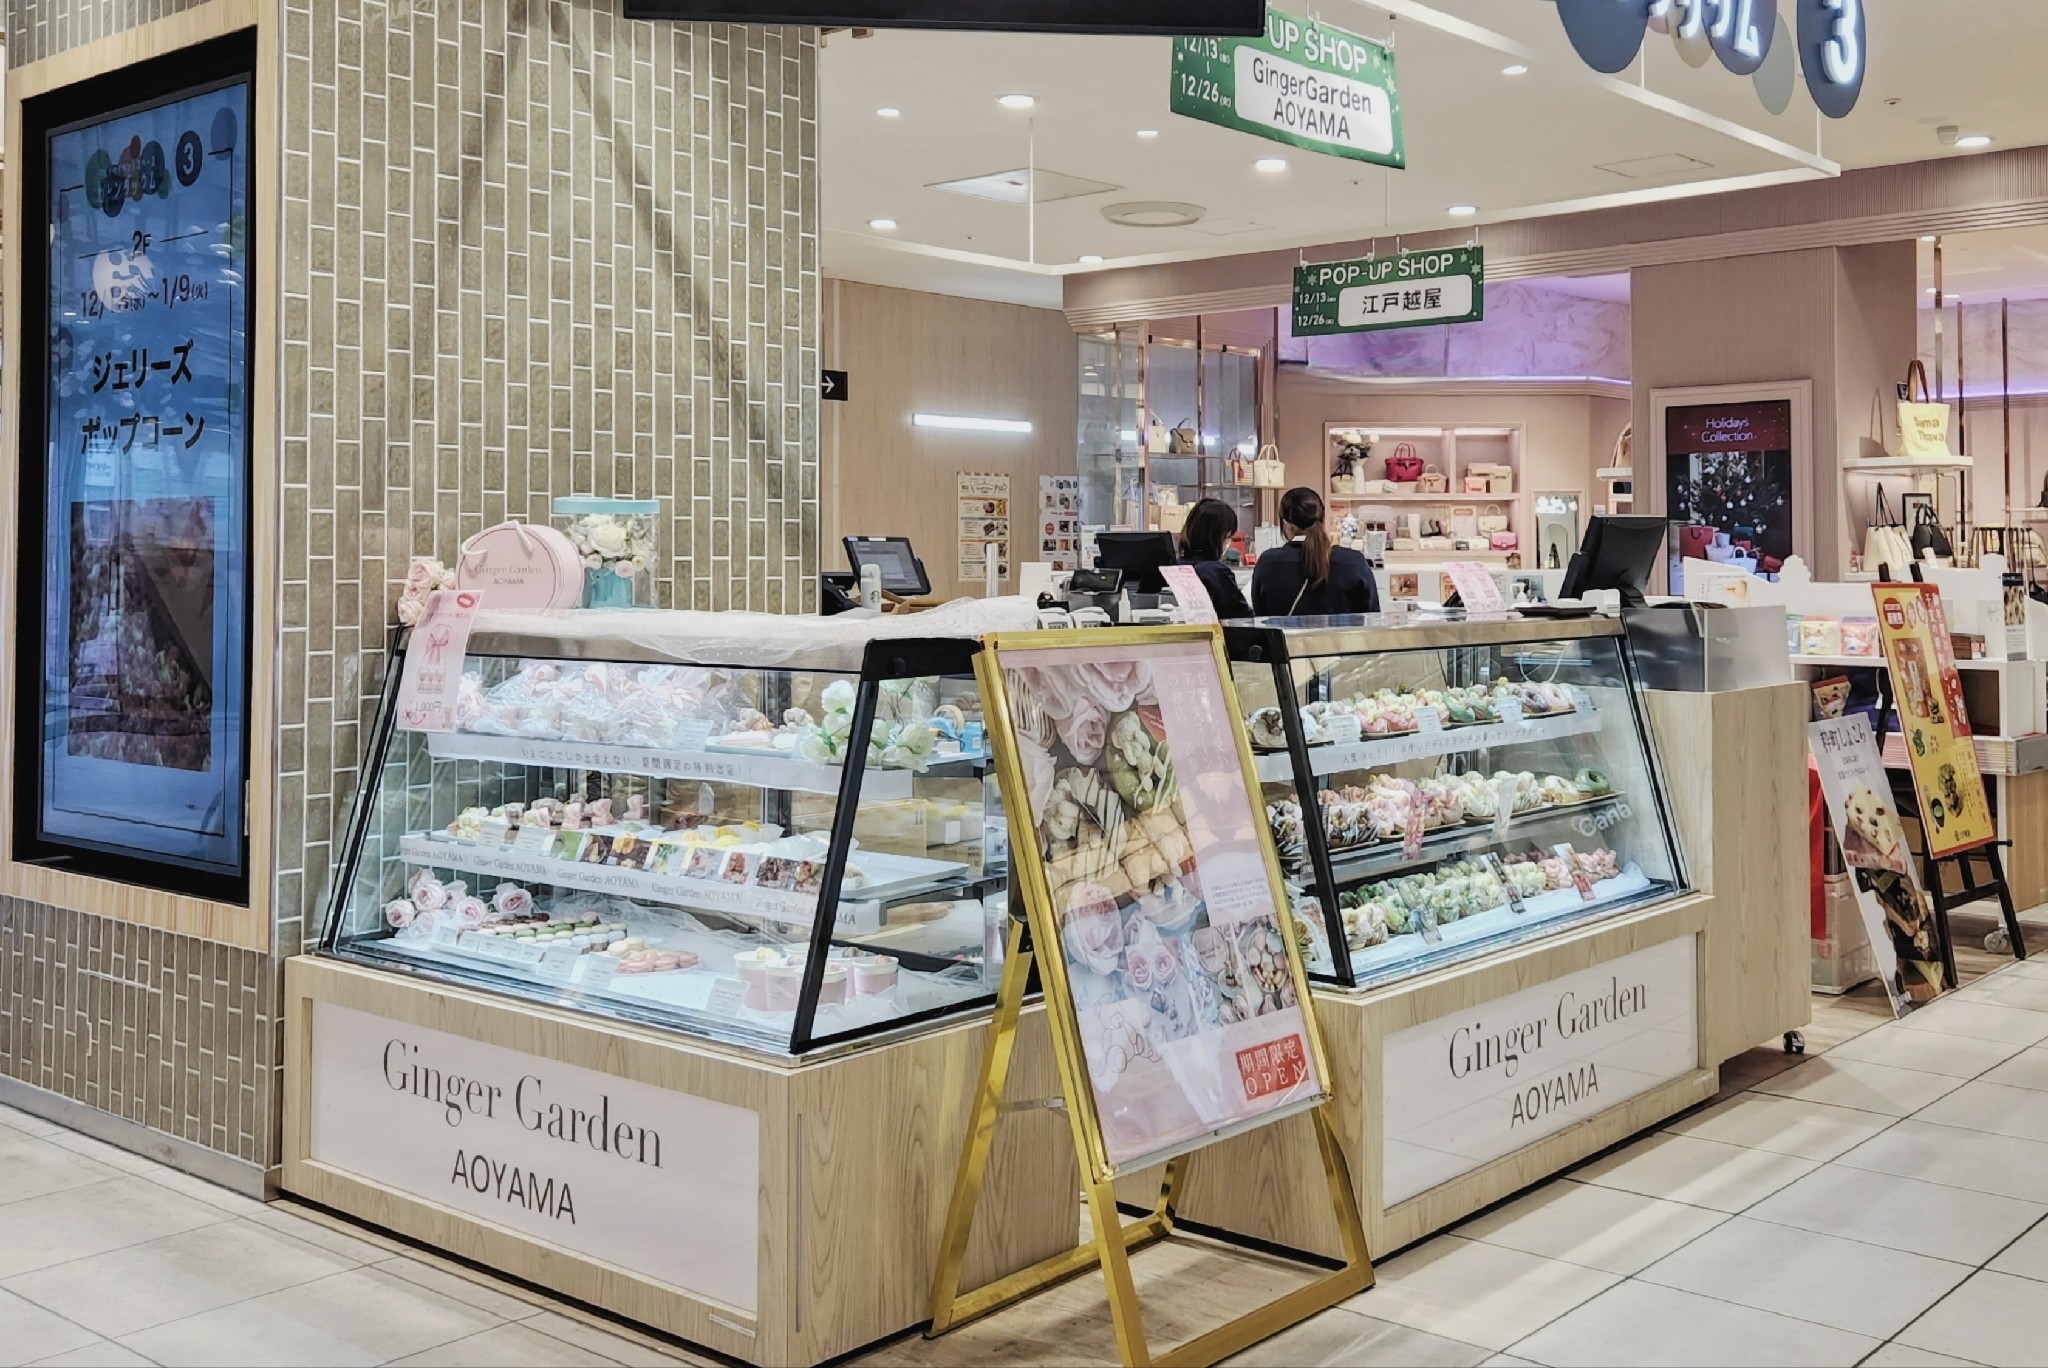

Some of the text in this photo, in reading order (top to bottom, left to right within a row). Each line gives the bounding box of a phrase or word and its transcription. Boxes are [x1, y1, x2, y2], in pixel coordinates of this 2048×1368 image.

[1304, 28, 1367, 73] SHOP
[1821, 0, 1857, 84] 3
[1253, 57, 1372, 114] GingerGarden
[1273, 97, 1351, 141] AOYAMA
[183, 142, 195, 176] 3
[132, 230, 152, 257] 2F
[1319, 253, 1454, 286] POP-UP SHOP
[1362, 287, 1442, 315] 江戸越屋
[92, 338, 195, 394] ジェリーズ
[81, 412, 205, 456] ポップコーン
[1701, 430, 1753, 443] Collection
[509, 564, 542, 574] Garden
[605, 874, 641, 889] AOYAMA
[702, 890, 741, 904] AOYAMA
[1449, 976, 1646, 1079] Ginger Garden
[1239, 1038, 1299, 1074] 期間限定
[1245, 1060, 1306, 1095] OPEN
[1510, 1062, 1599, 1129] AOYAMA
[383, 1038, 664, 1170] Ginger Garden
[451, 1149, 576, 1225] AOYAMA
